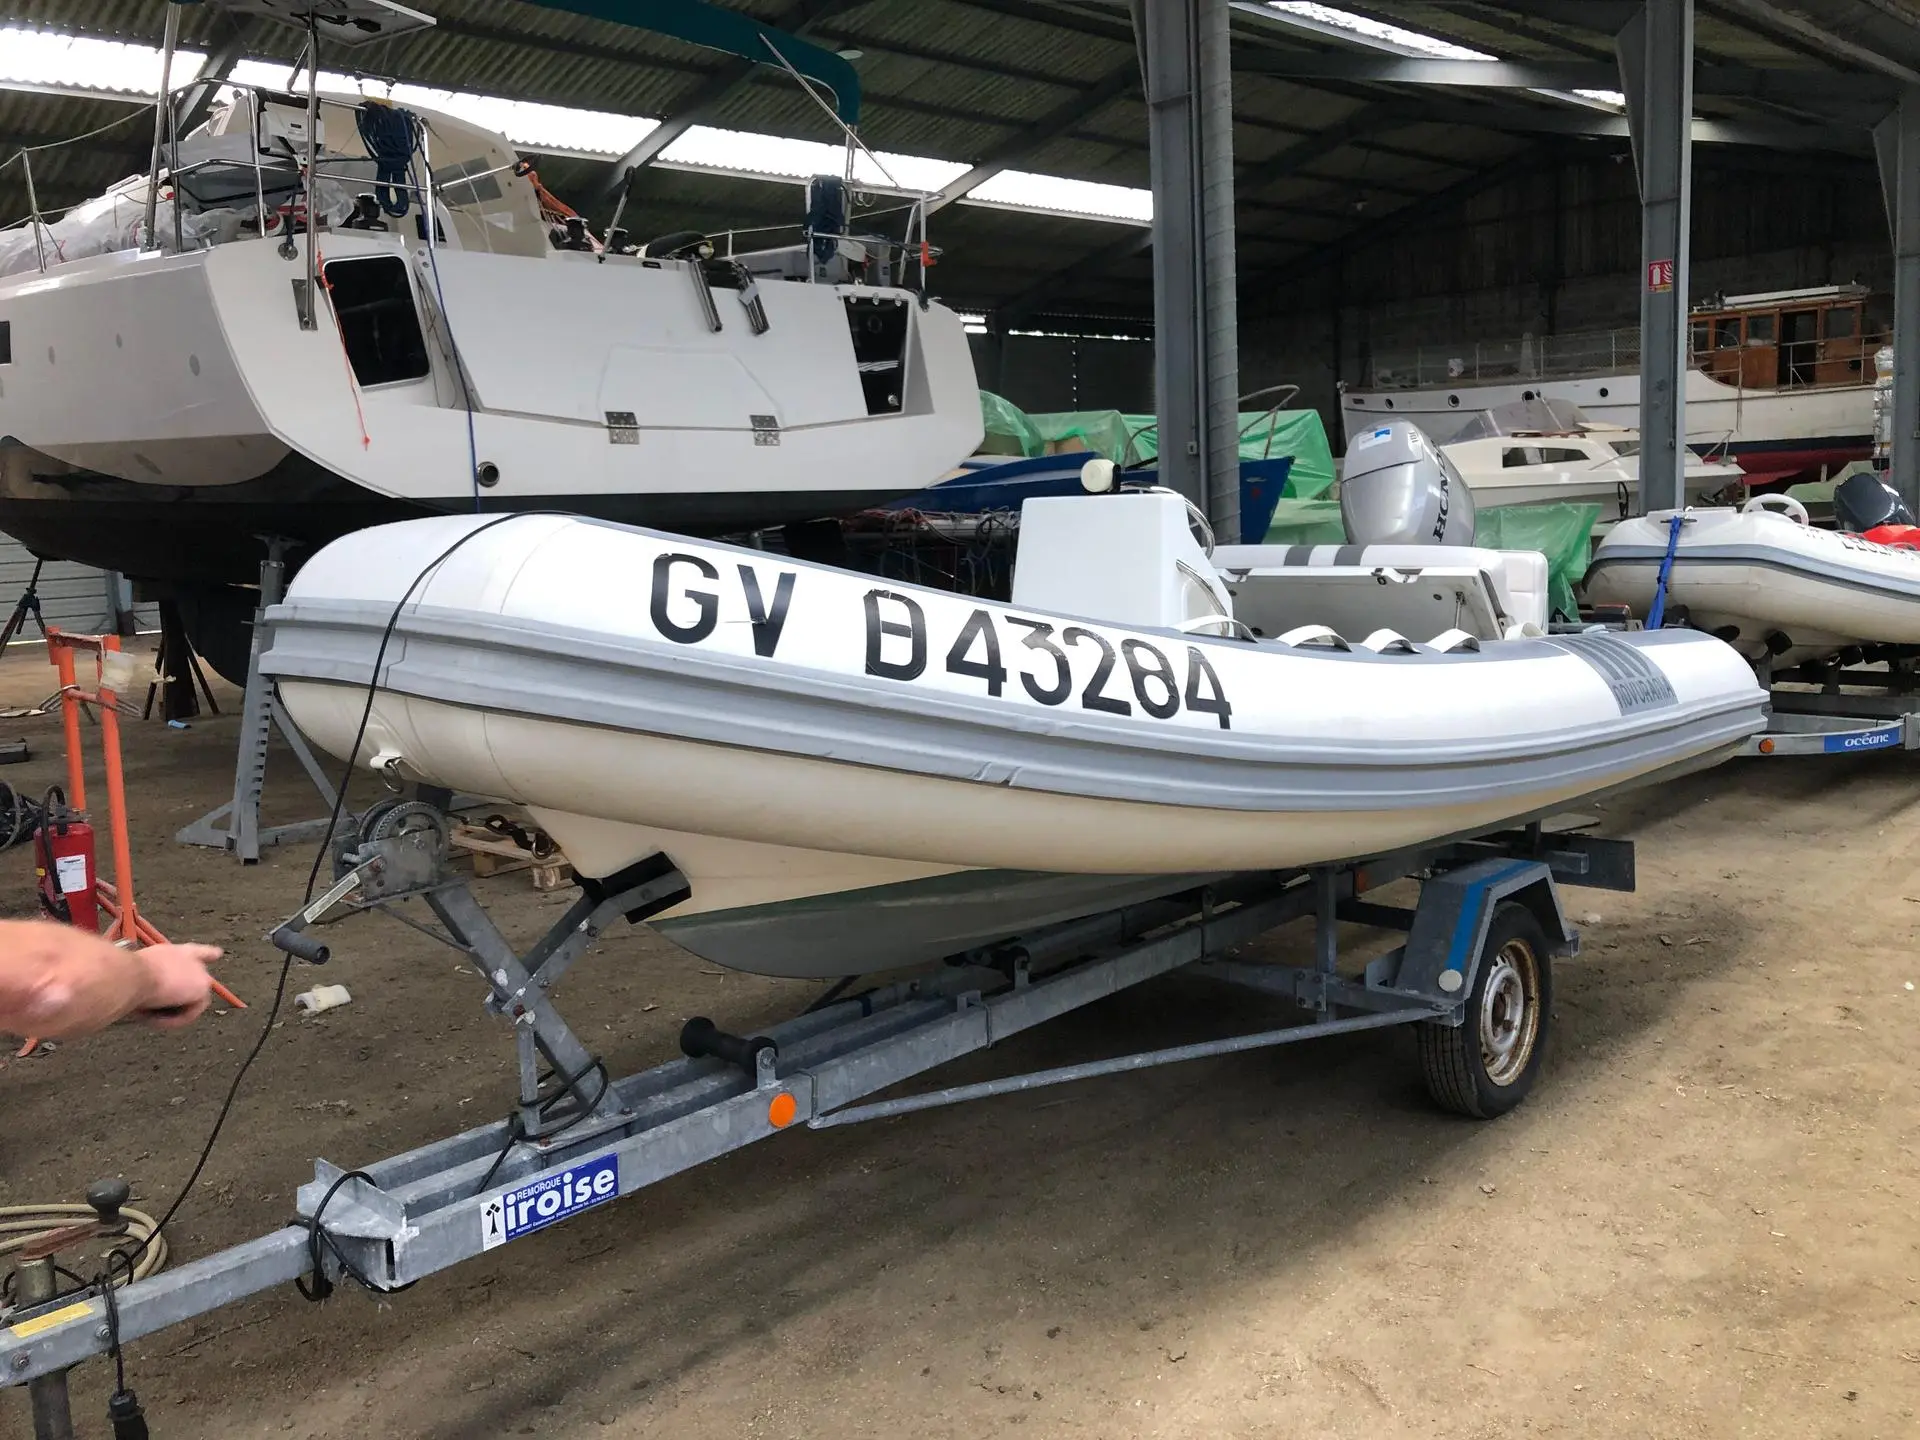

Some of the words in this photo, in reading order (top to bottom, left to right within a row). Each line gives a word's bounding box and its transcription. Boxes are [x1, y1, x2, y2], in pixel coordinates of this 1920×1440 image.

[650, 553, 797, 658] GV
[505, 1169, 615, 1231] iroise
[516, 1177, 562, 1201] REMORQUE
